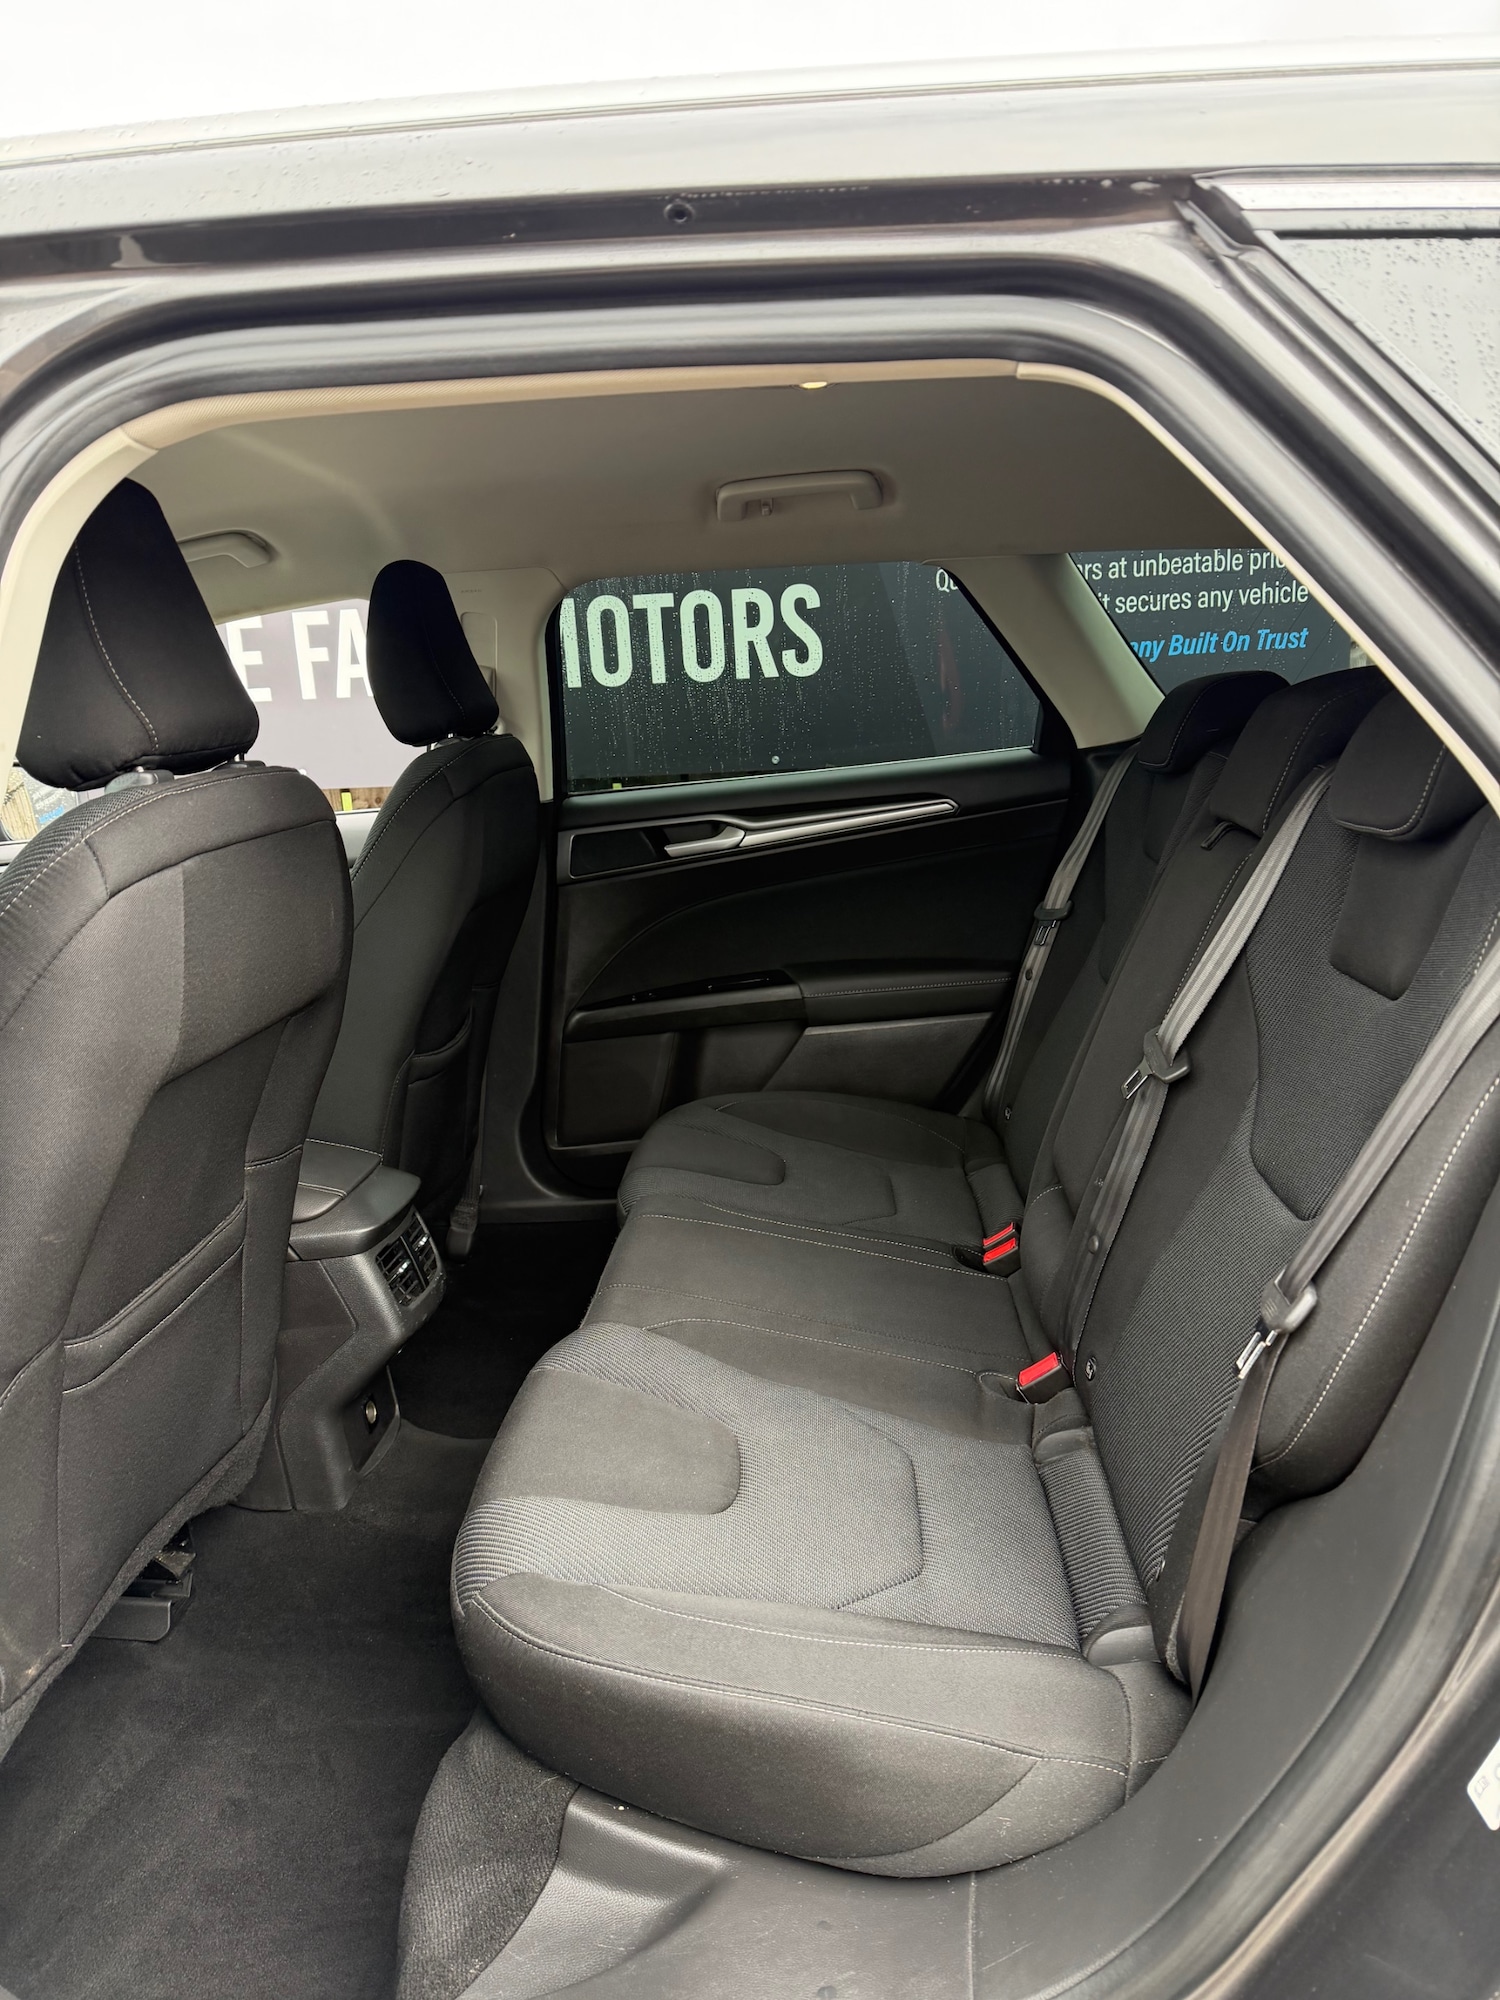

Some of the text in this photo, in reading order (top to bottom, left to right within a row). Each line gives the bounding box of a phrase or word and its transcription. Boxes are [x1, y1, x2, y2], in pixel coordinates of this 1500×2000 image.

[1108, 557, 1128, 579] at
[1133, 548, 1243, 578] unbeatable
[1098, 580, 1309, 614] t secures any vehicle
[1168, 631, 1218, 656] Built
[1222, 630, 1250, 653] On
[1257, 628, 1309, 651] Trust
